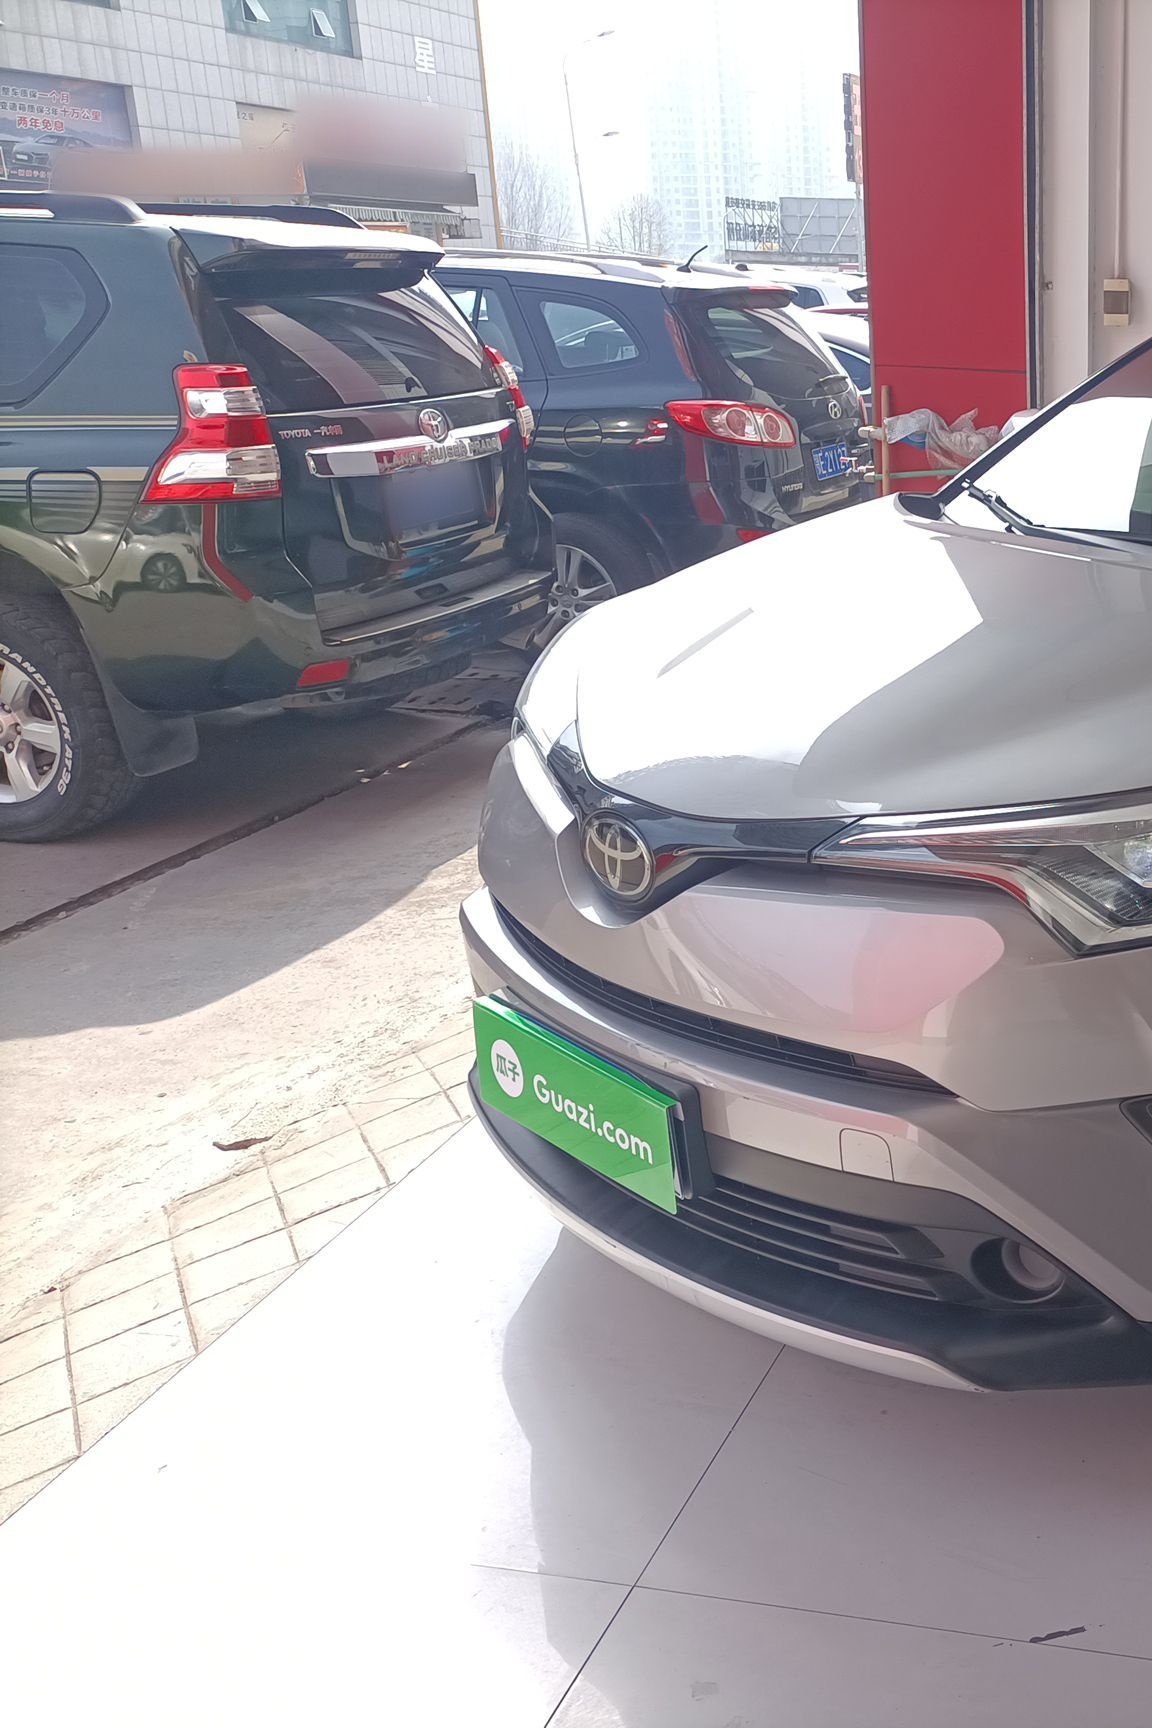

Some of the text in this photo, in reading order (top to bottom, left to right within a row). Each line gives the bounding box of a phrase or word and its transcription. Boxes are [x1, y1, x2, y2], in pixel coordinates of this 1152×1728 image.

[17, 115, 65, 132] 两年免息
[278, 429, 312, 440] TOYOTA
[382, 438, 498, 468] LAND CRUISER PRADO
[495, 1053, 520, 1083] 瓜子
[533, 1074, 654, 1165] Guazi.com
